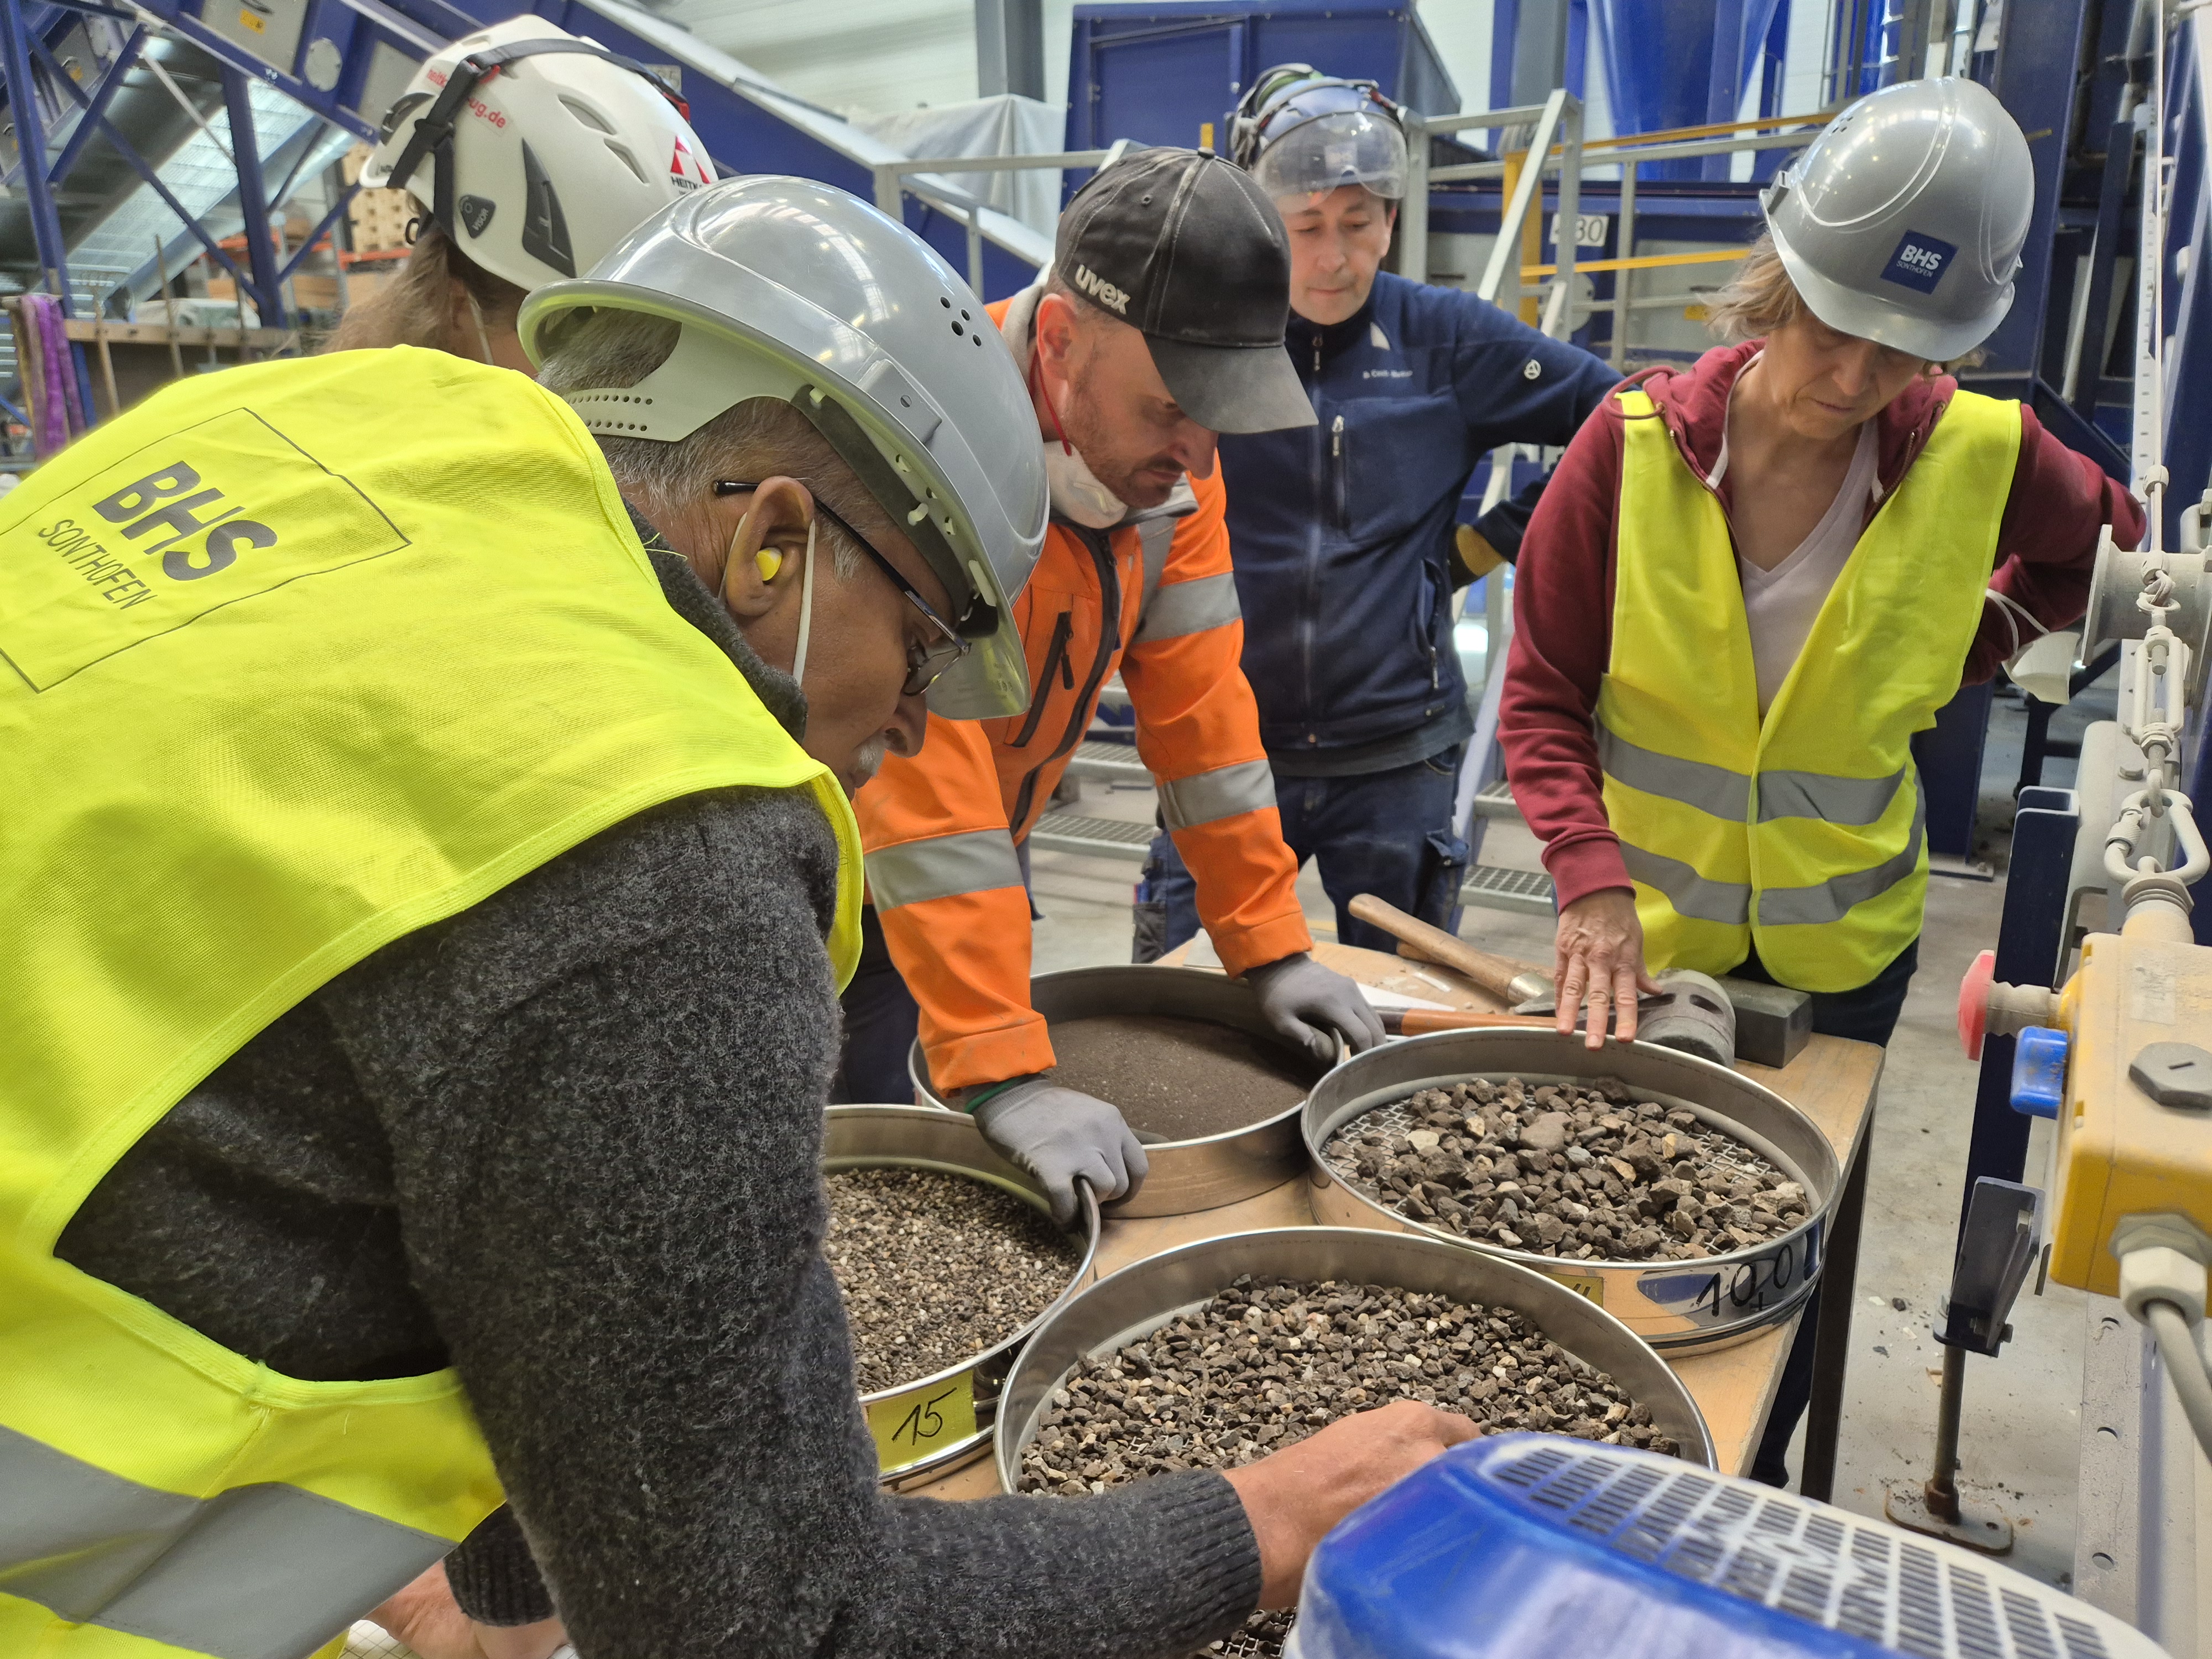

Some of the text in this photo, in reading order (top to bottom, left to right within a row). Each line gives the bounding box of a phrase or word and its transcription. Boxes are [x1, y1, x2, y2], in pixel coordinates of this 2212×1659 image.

[468, 97, 506, 128] ug.de
[472, 207, 489, 231] VISOR
[1554, 218, 1603, 242] 30
[1896, 260, 1934, 278] SONTHOFEN
[1900, 244, 1942, 270] BHS
[1075, 264, 1131, 315] uvex
[92, 460, 278, 581] BHS
[39, 519, 158, 610] SONTHOFEN
[891, 1386, 957, 1447] 15
